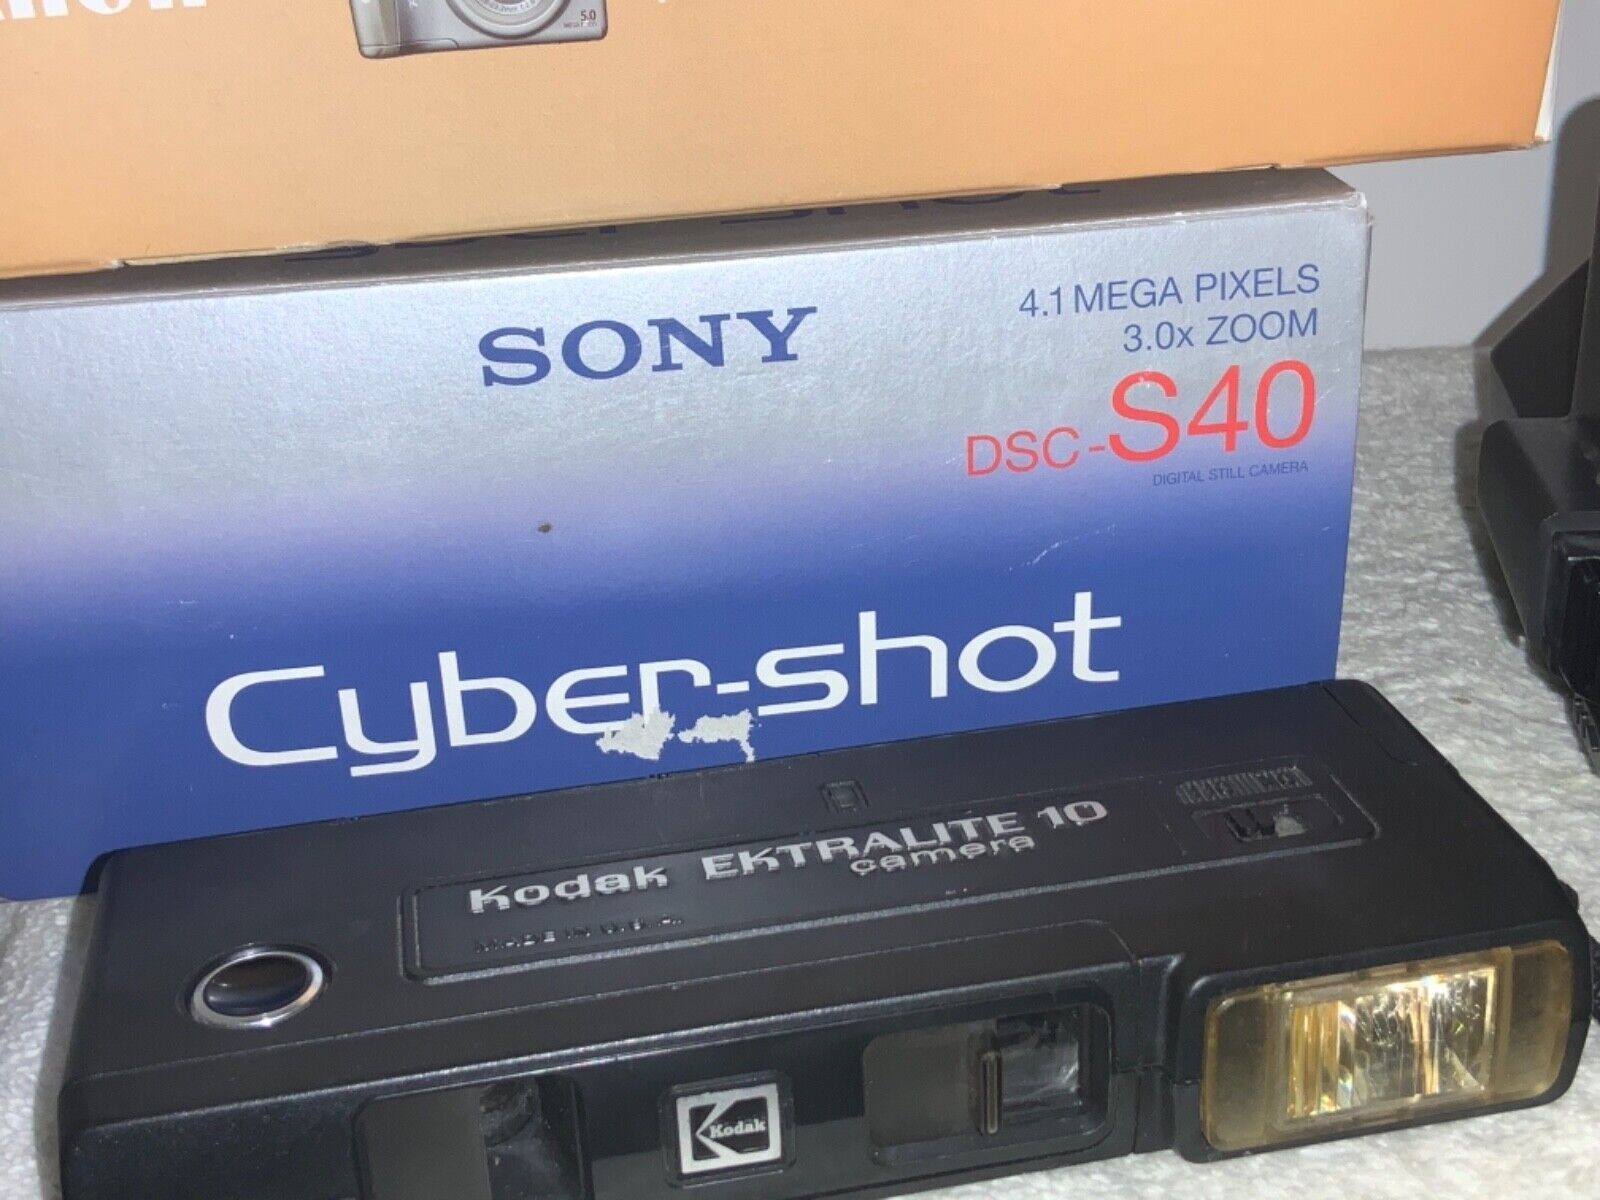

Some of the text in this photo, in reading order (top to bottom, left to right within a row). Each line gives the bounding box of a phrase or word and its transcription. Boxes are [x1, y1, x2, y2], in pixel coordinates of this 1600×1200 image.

[1074, 276, 1183, 313] MEGA
[1195, 264, 1320, 302] PIXELS
[479, 306, 817, 387] SONY
[1123, 308, 1318, 352] 3.0x ZOOM
[1153, 460, 1309, 486] DIGITAL STILL CAMERA
[205, 591, 1122, 777] Cyber-shot
[469, 801, 1108, 914] Kodak EKTRALITE 10
[850, 834, 1036, 876] camera
[709, 1118, 767, 1139] Kodak
